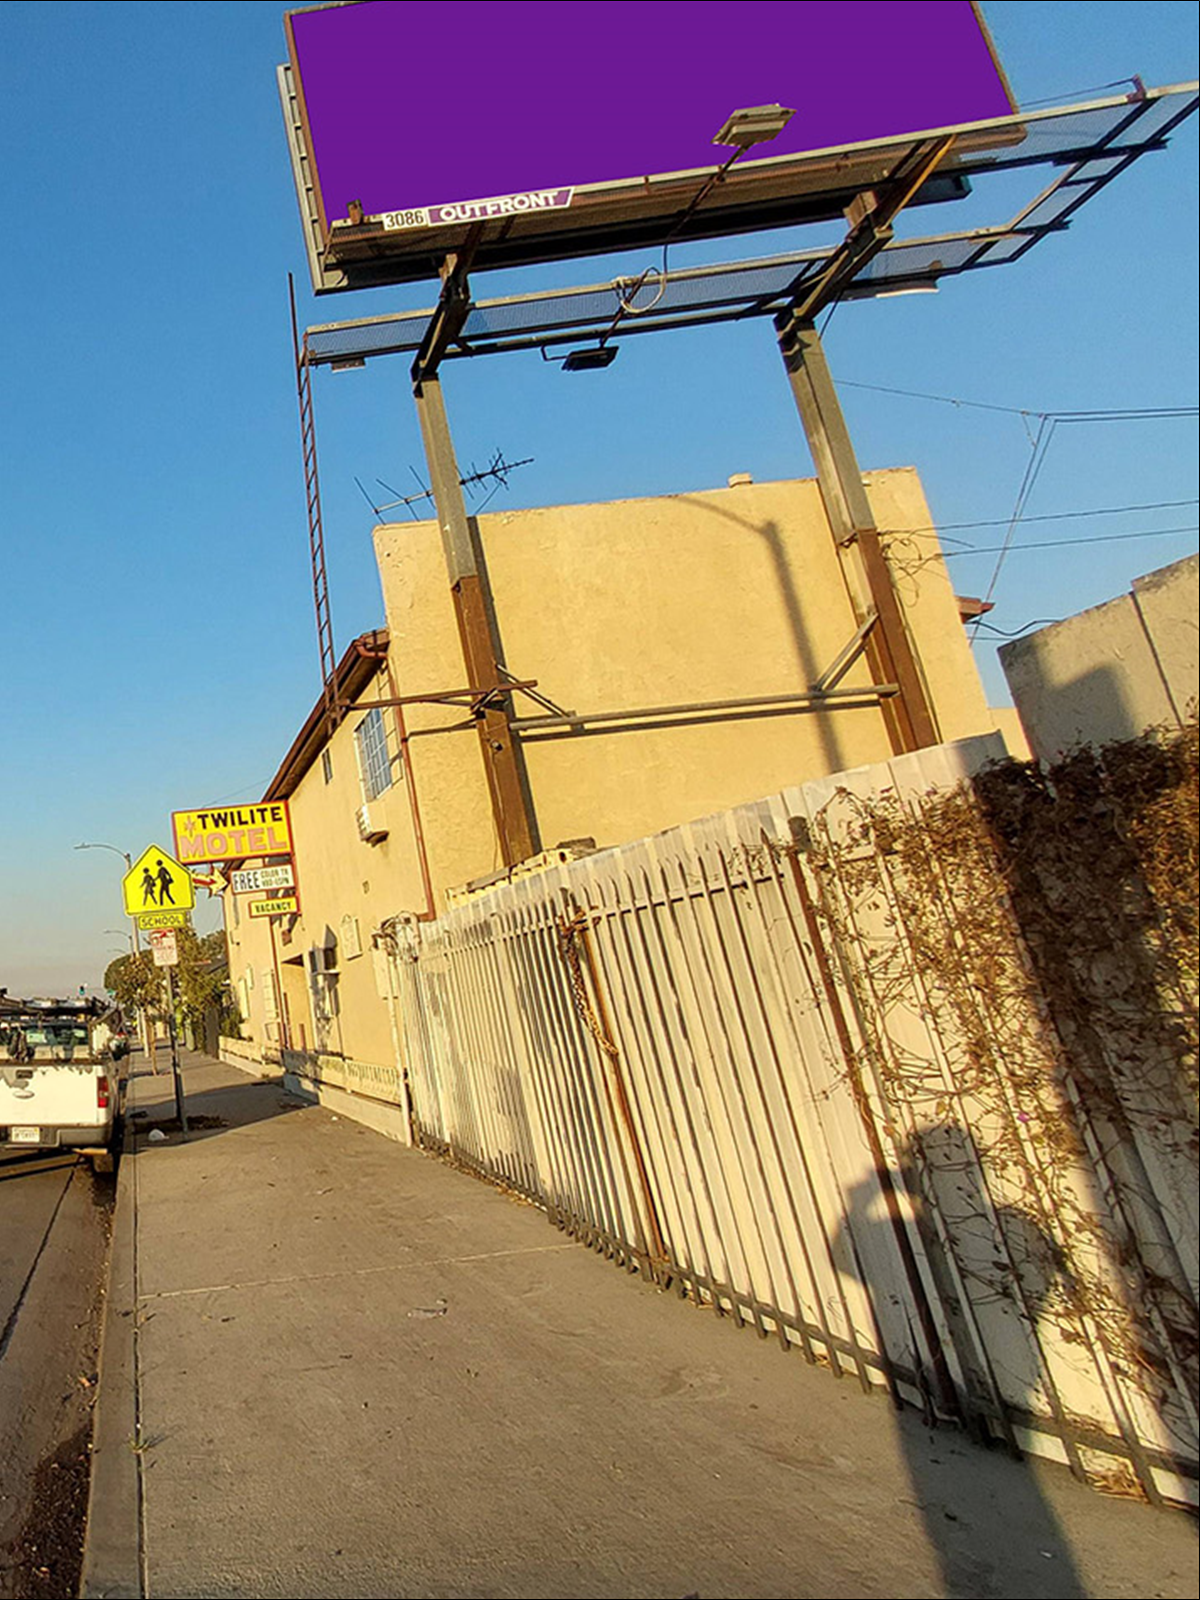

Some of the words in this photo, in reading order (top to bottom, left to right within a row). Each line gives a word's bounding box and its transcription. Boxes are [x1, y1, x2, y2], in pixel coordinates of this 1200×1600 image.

[439, 191, 559, 222] OUTFRONT
[385, 209, 424, 229] 3086
[197, 806, 283, 830] TWILITE
[179, 827, 287, 859] MOTEL
[232, 871, 260, 891] FREE
[254, 901, 292, 913] VACANCY
[141, 915, 182, 927] SCHOOL
